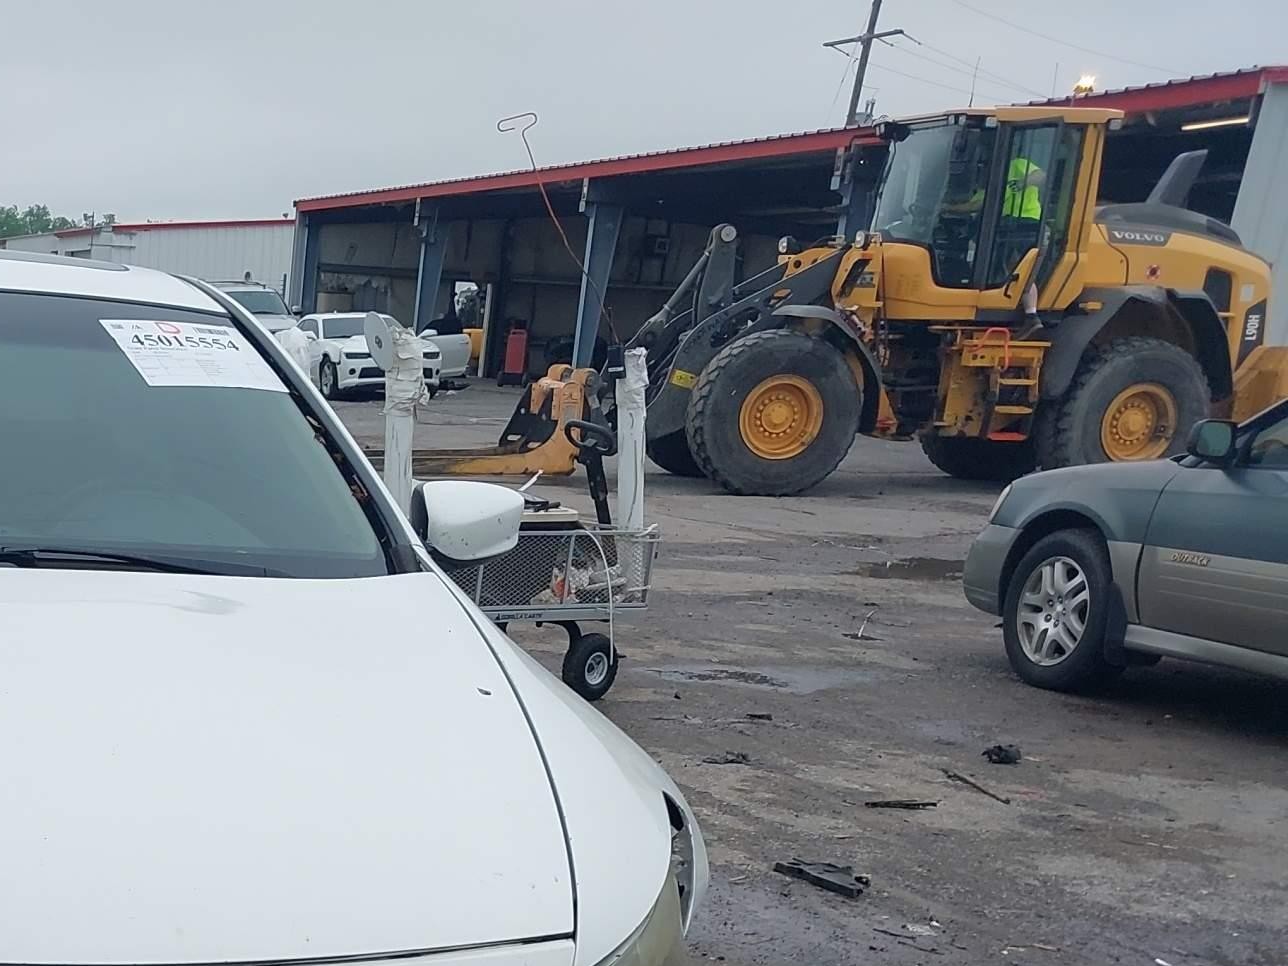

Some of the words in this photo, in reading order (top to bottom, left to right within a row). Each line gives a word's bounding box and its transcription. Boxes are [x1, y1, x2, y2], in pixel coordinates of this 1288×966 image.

[1111, 230, 1165, 242] VOLVO
[1244, 314, 1261, 341] L90H
[131, 334, 240, 351] 45015554
[1171, 552, 1210, 567] OUTBACK
